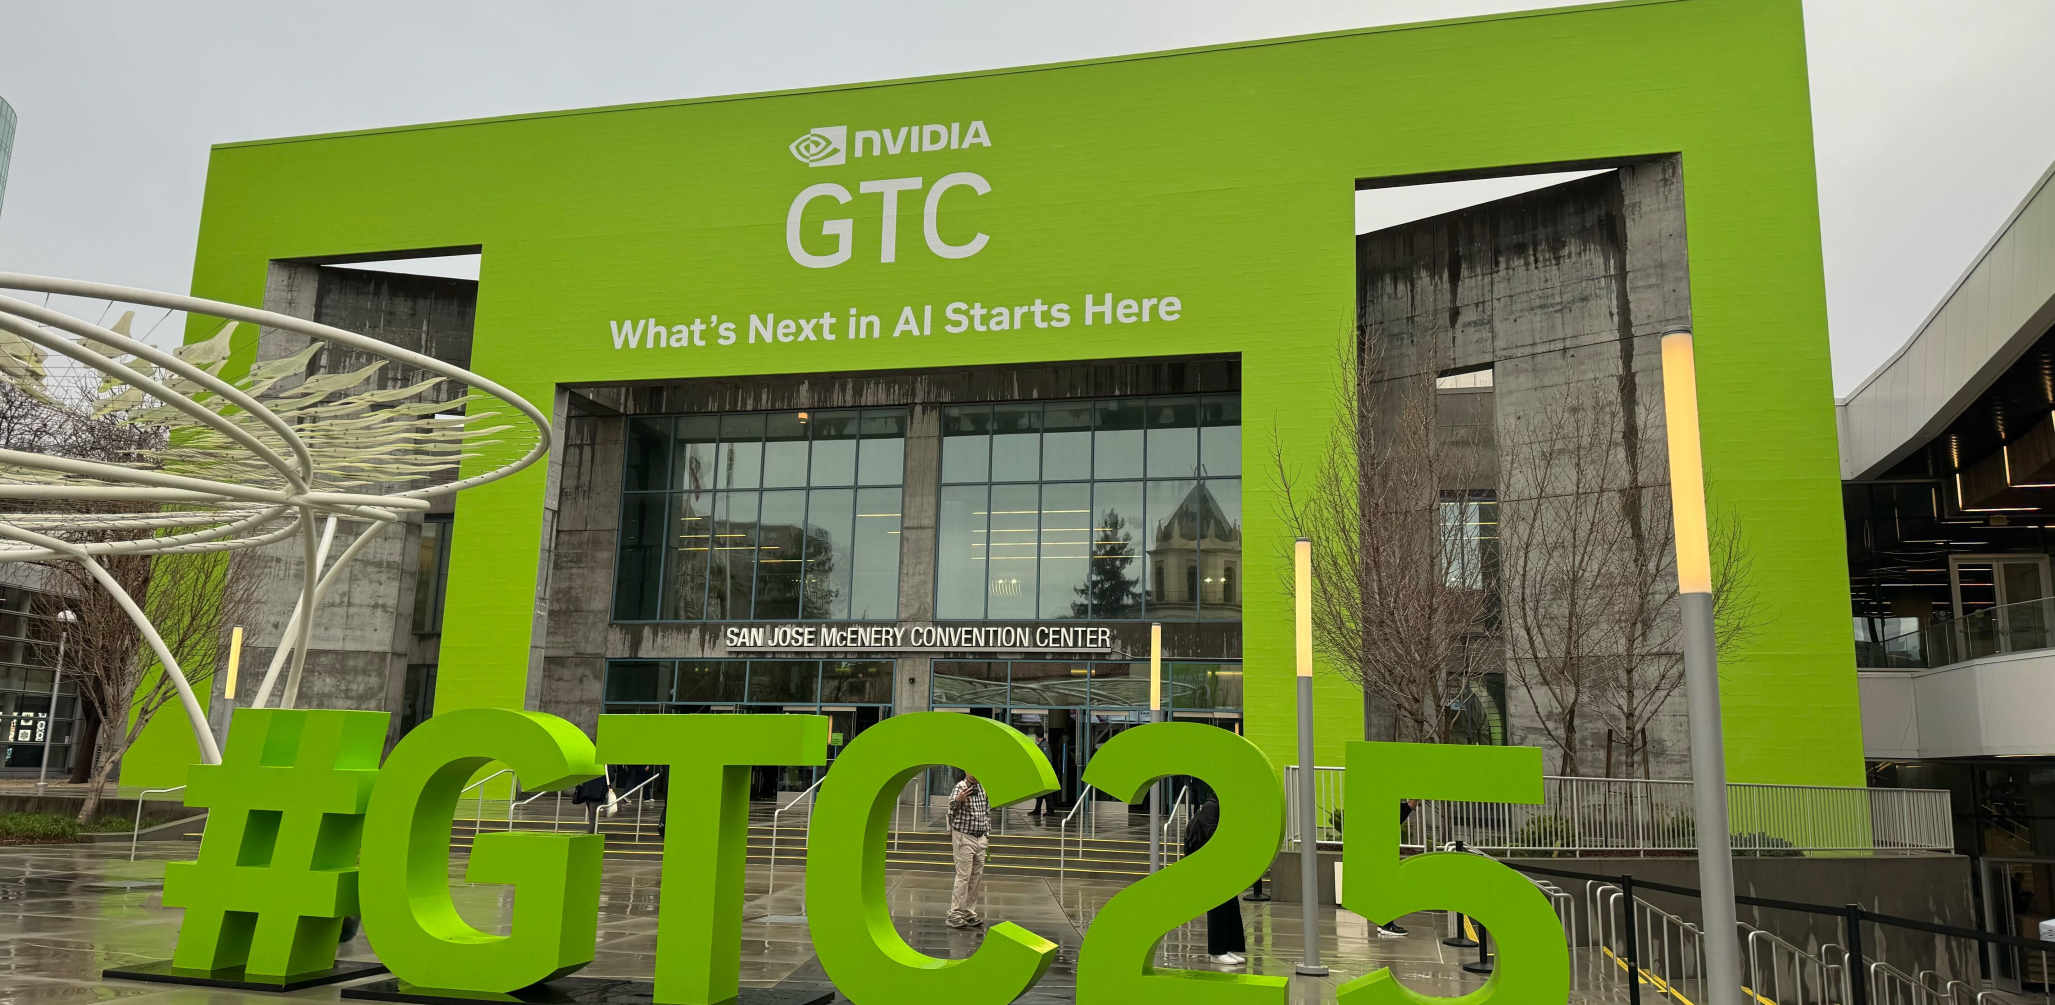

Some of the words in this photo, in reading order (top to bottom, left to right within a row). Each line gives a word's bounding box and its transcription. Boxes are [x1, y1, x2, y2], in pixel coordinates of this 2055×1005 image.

[854, 121, 992, 158] NVIDIA
[785, 172, 992, 269] GTC
[609, 315, 737, 350] What's
[748, 311, 837, 344] Next
[848, 307, 881, 340] in
[892, 304, 932, 338] AI
[944, 299, 1071, 334] Starts
[1084, 293, 1182, 326] Here
[725, 627, 765, 647] SAN
[767, 627, 816, 647] JOSE
[820, 627, 906, 647] McENERY
[910, 627, 1030, 647] CONVENTION
[1035, 627, 1111, 648] CENTER
[162, 707, 1570, 1005] #GTC25
